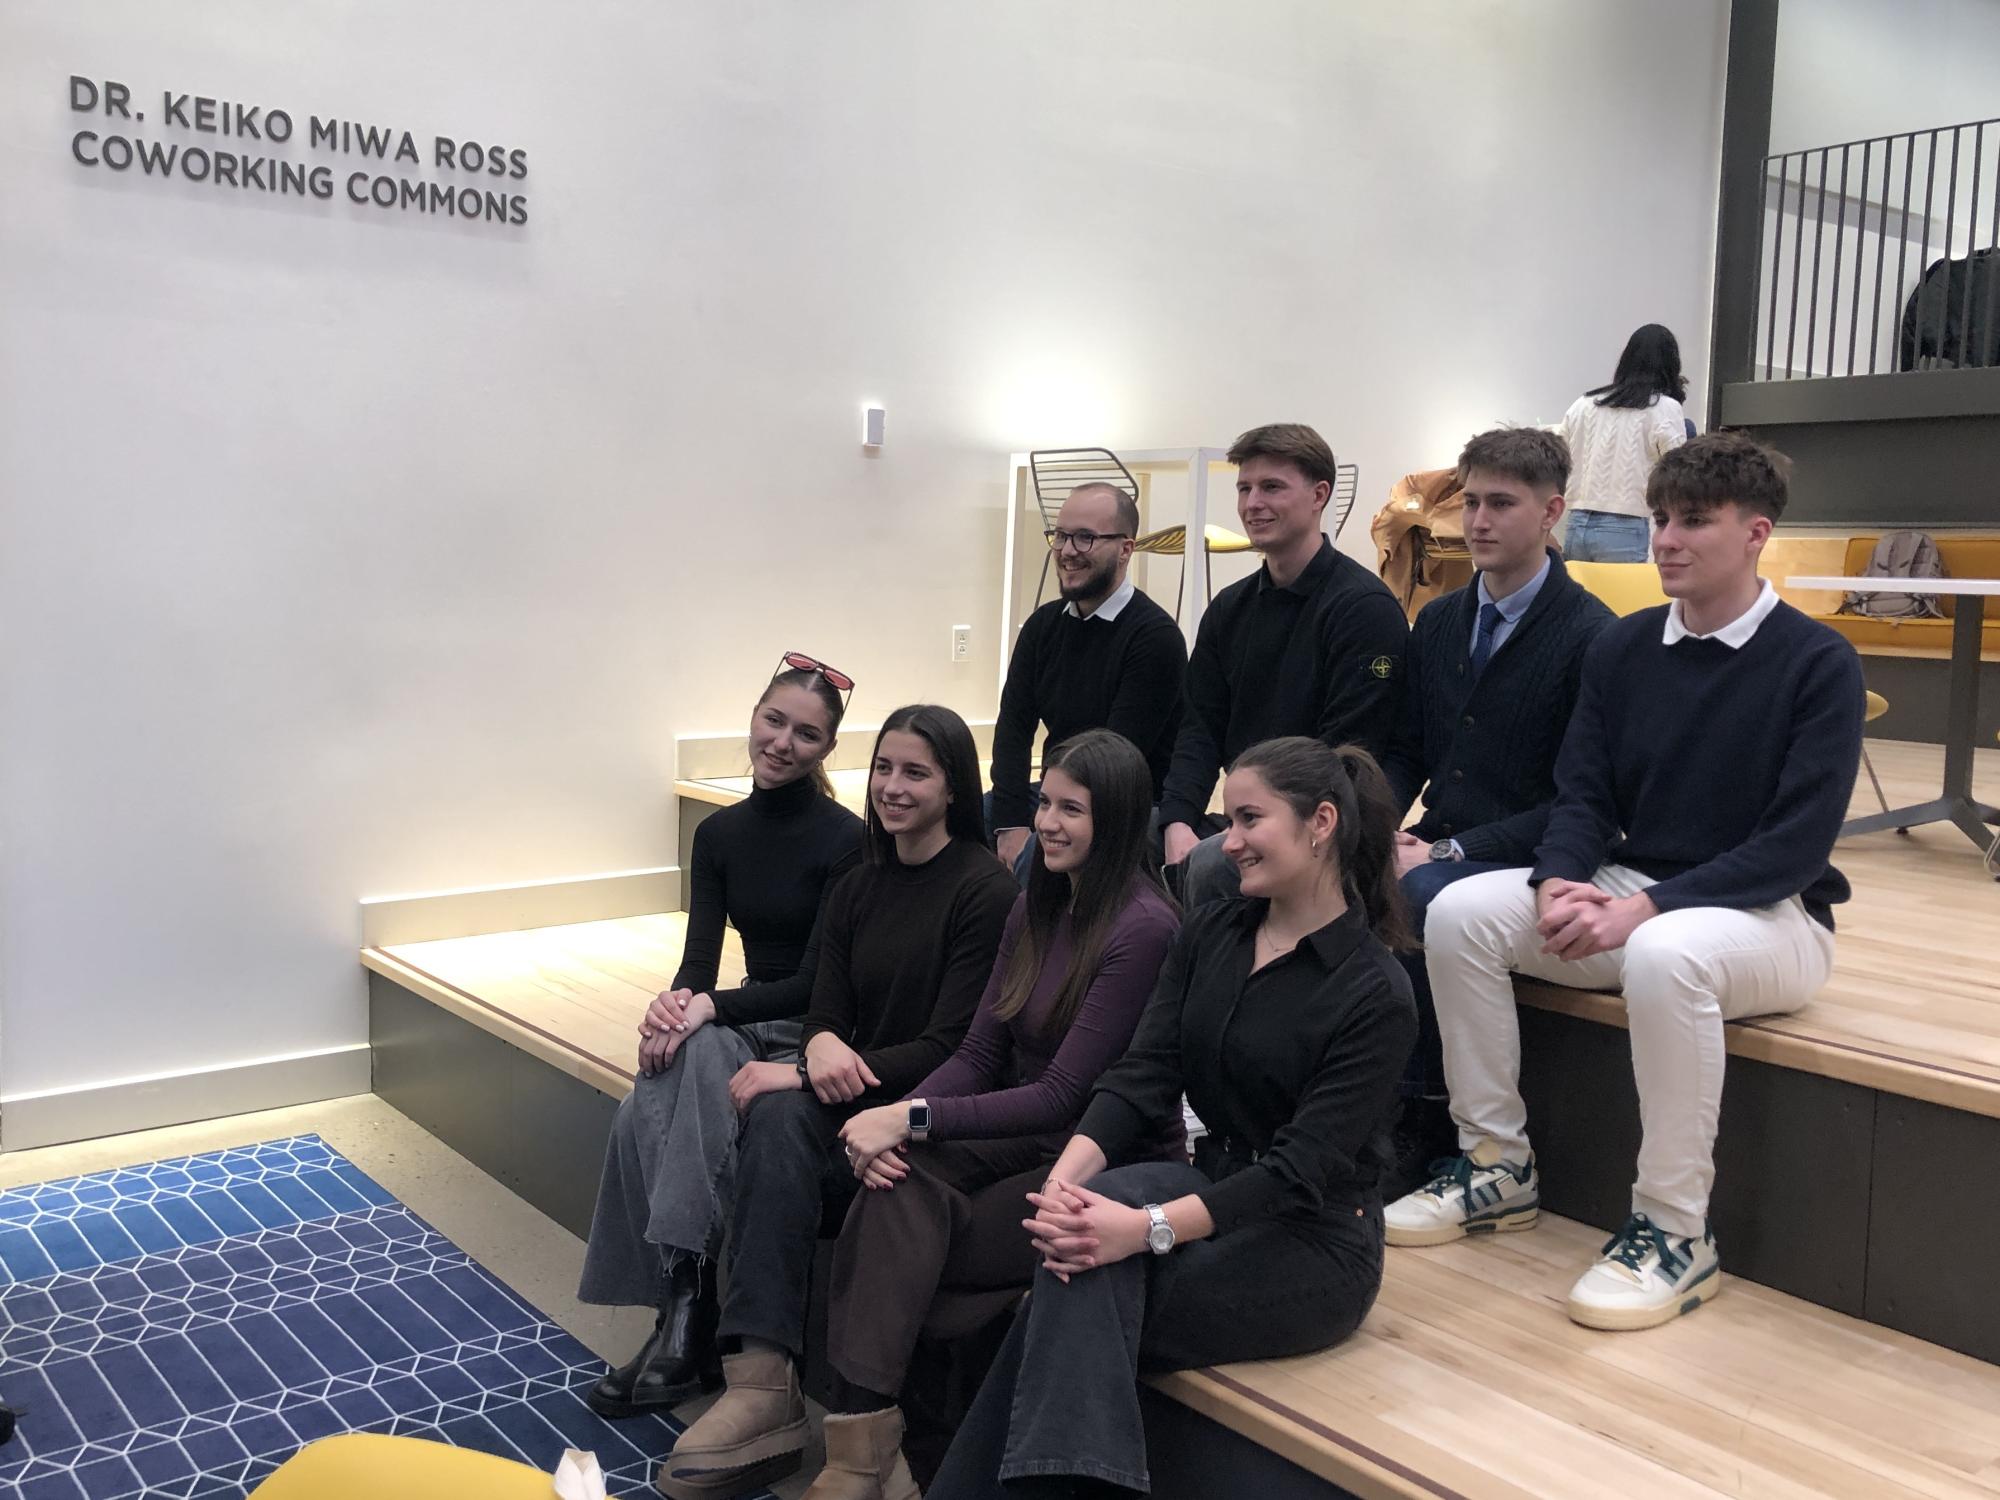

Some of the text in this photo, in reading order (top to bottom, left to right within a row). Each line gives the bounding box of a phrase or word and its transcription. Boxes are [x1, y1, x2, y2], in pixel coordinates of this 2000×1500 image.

[70, 75, 528, 180] DR. KEIKO MIWA ROSS
[71, 130, 528, 225] COWORKING COMMONS
